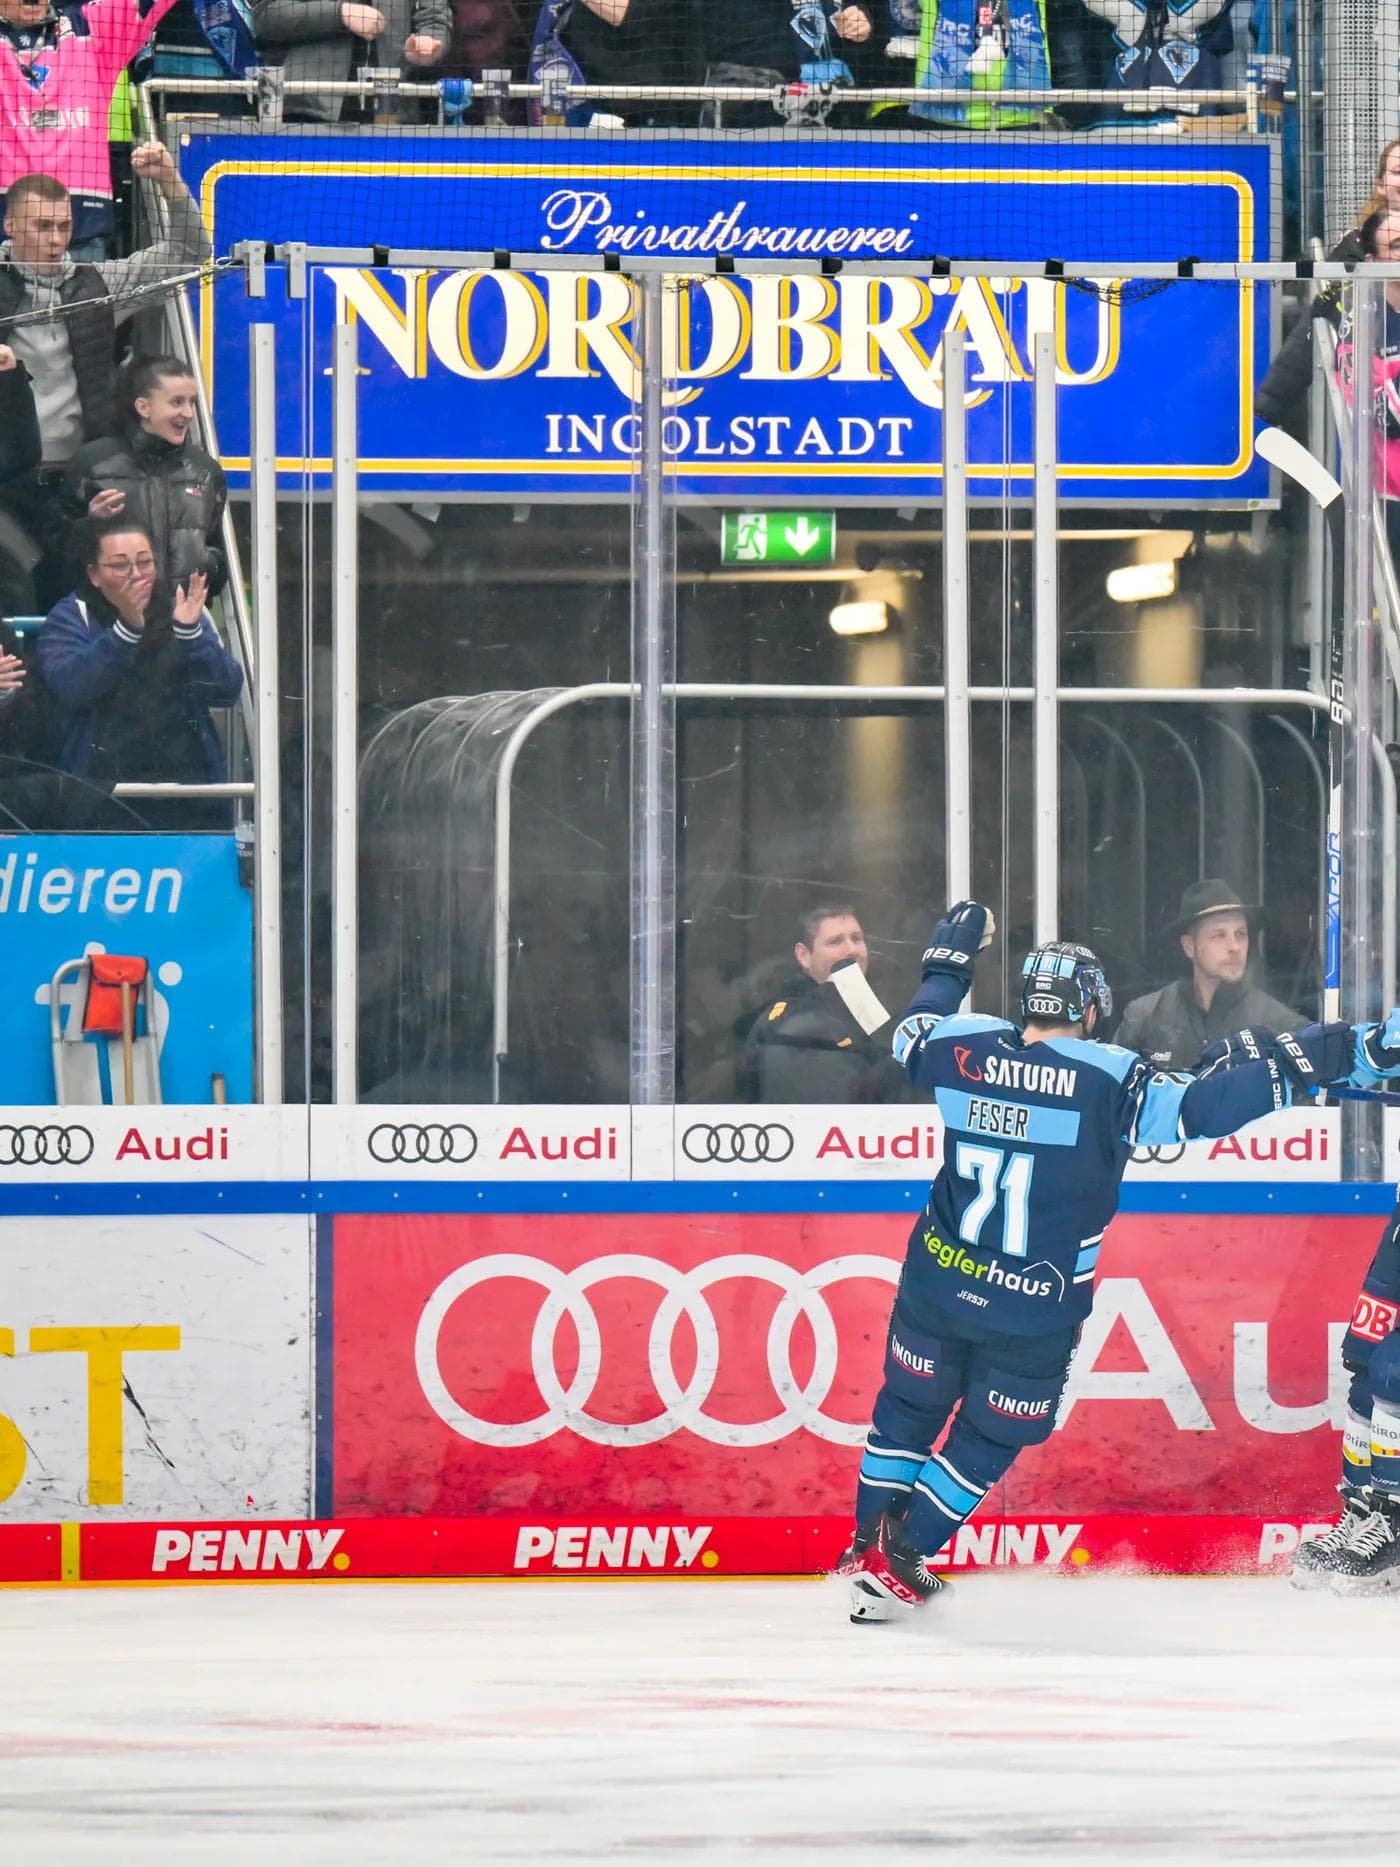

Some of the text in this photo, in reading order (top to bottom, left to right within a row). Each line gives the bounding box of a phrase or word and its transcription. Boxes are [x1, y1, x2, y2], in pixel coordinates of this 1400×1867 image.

[540, 187, 920, 255] Privatbrauerei
[323, 267, 1128, 409] NORDBRÄU
[546, 412, 914, 457] INGOLSTADT
[983, 1054, 1078, 1099] SATURN
[967, 1096, 1031, 1139] FESER
[115, 1126, 229, 1162] Audi
[499, 1125, 618, 1162] Audi
[815, 1125, 936, 1162] Audi
[1206, 1127, 1329, 1162] Audi
[955, 1140, 1035, 1259] 71
[1352, 1297, 1394, 1339] DB
[987, 1389, 1052, 1417] CINQUE
